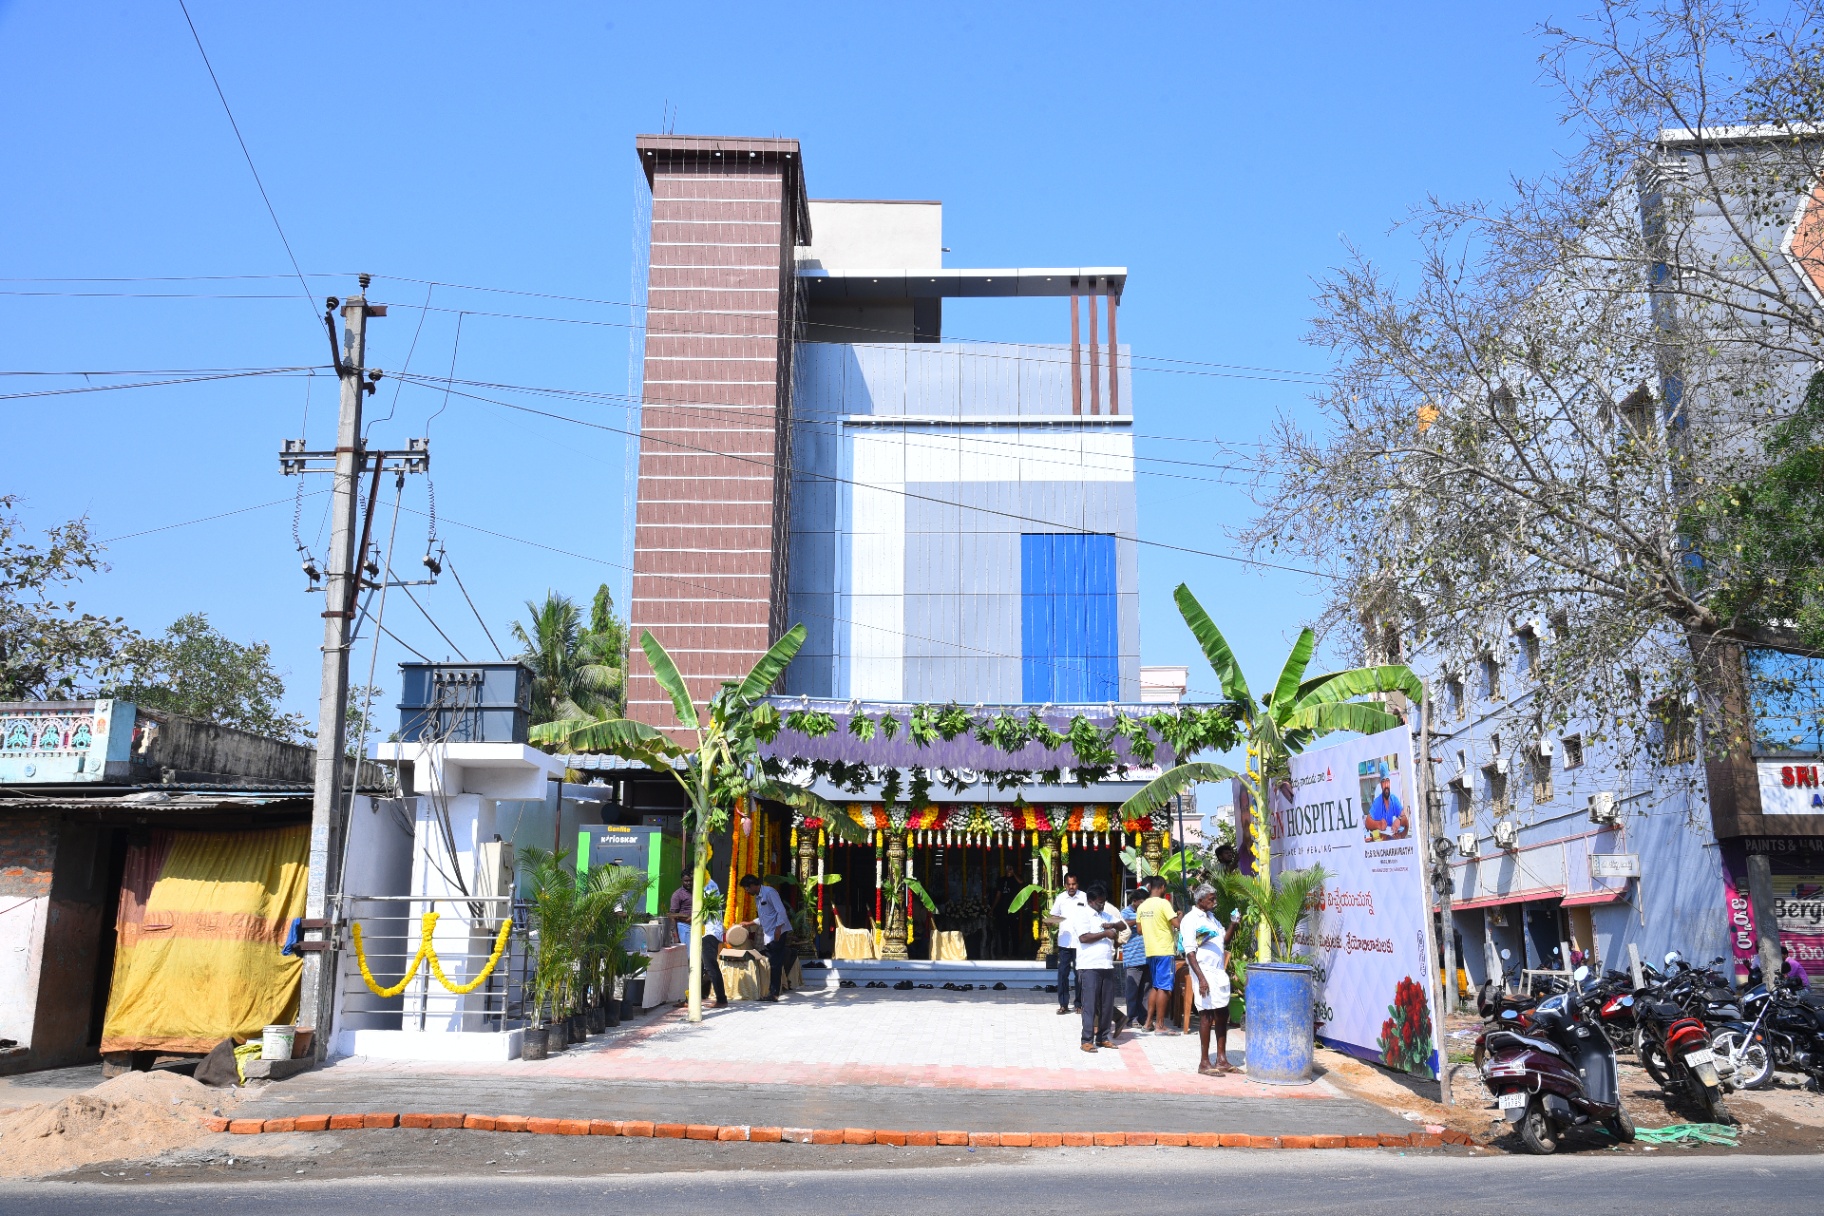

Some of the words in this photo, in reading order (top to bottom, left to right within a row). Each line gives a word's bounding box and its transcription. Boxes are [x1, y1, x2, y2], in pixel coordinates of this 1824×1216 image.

[1781, 765, 1819, 787] SRI
[1286, 797, 1359, 838] HOSPITAL
[1745, 839, 1786, 851] PAINTS
[1787, 839, 1796, 851] &
[1775, 898, 1824, 925] Berg
